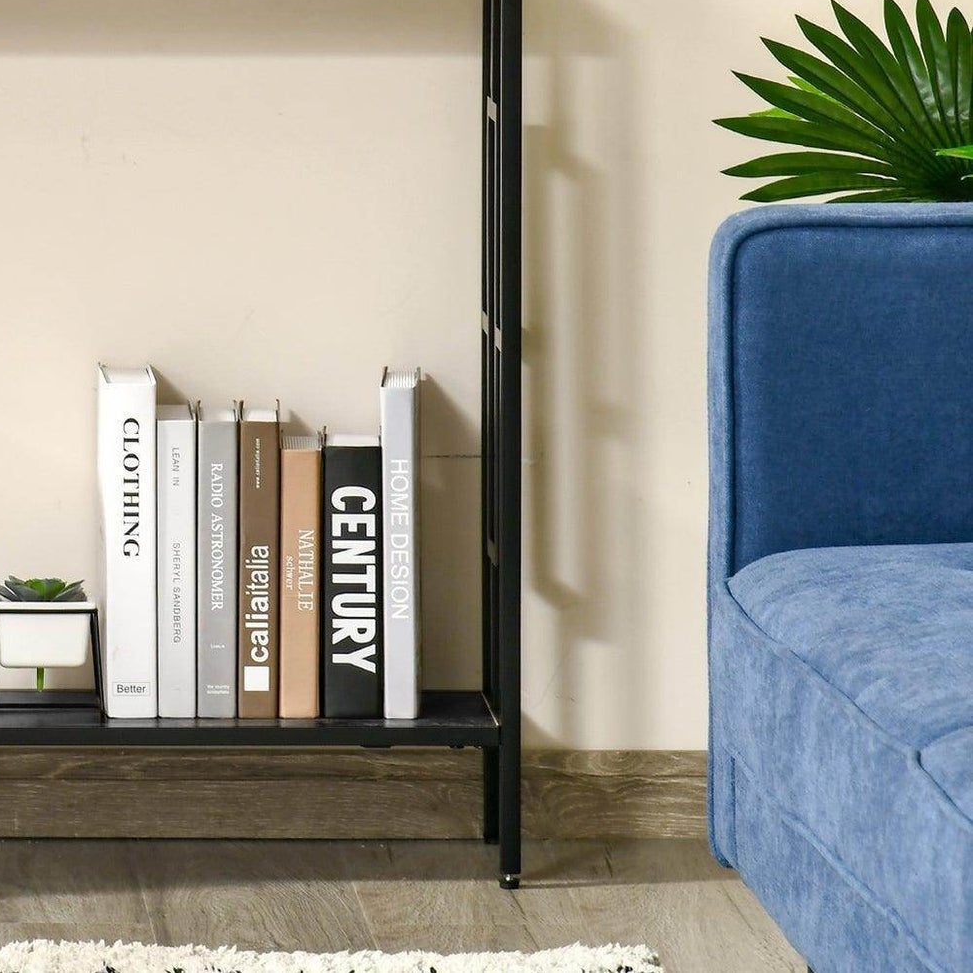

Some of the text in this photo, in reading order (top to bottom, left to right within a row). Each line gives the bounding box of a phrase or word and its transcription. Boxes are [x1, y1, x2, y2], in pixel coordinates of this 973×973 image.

[123, 417, 140, 557] CLOTHING
[172, 447, 180, 487] LEAN IN
[390, 459, 409, 526] HOME
[210, 463, 224, 610] RADIO ASTRONOMER
[298, 529, 314, 611] NATHALIE
[331, 486, 376, 673] CENTURY
[172, 542, 182, 643] SHERYL SANDBERG
[245, 545, 269, 662] caliaitalia
[116, 684, 146, 694] Better
